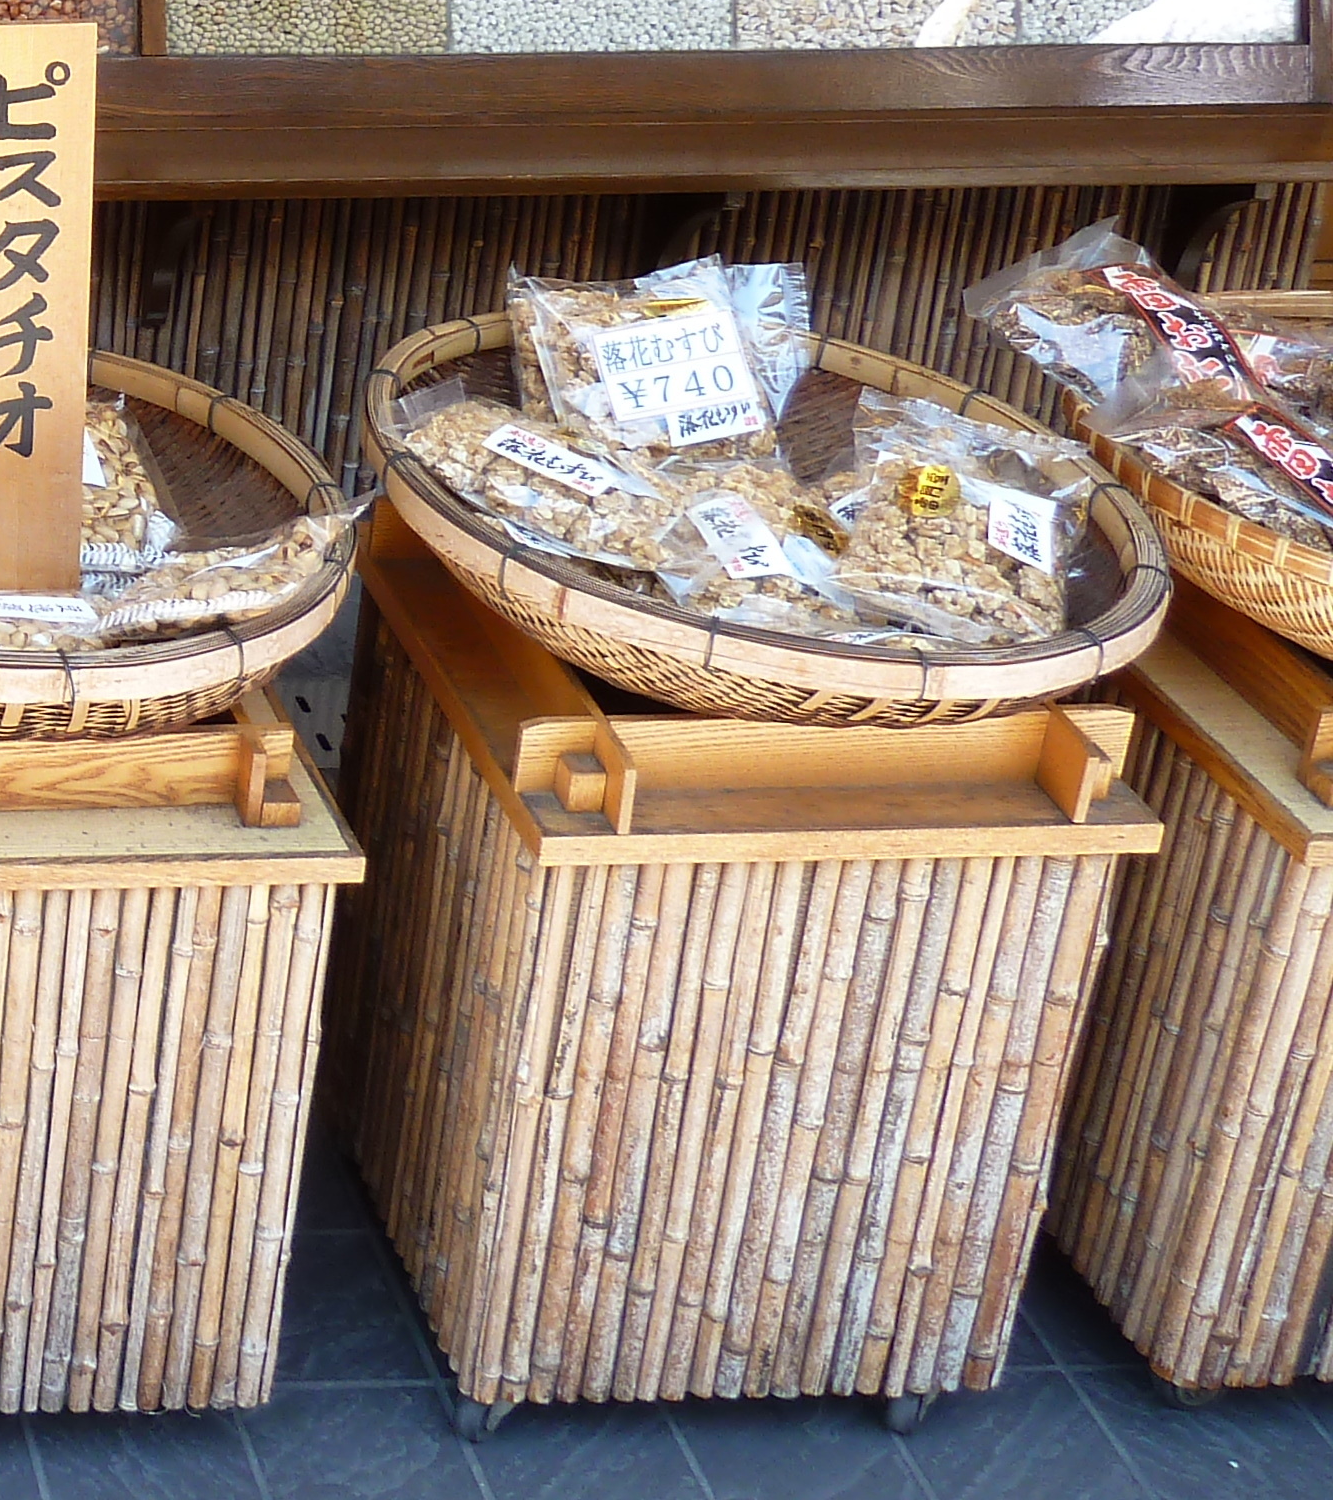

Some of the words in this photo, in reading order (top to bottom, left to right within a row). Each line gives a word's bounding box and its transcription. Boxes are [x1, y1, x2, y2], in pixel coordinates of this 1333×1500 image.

[601, 322, 726, 375] 落花むすび
[617, 364, 734, 409] ¥740
